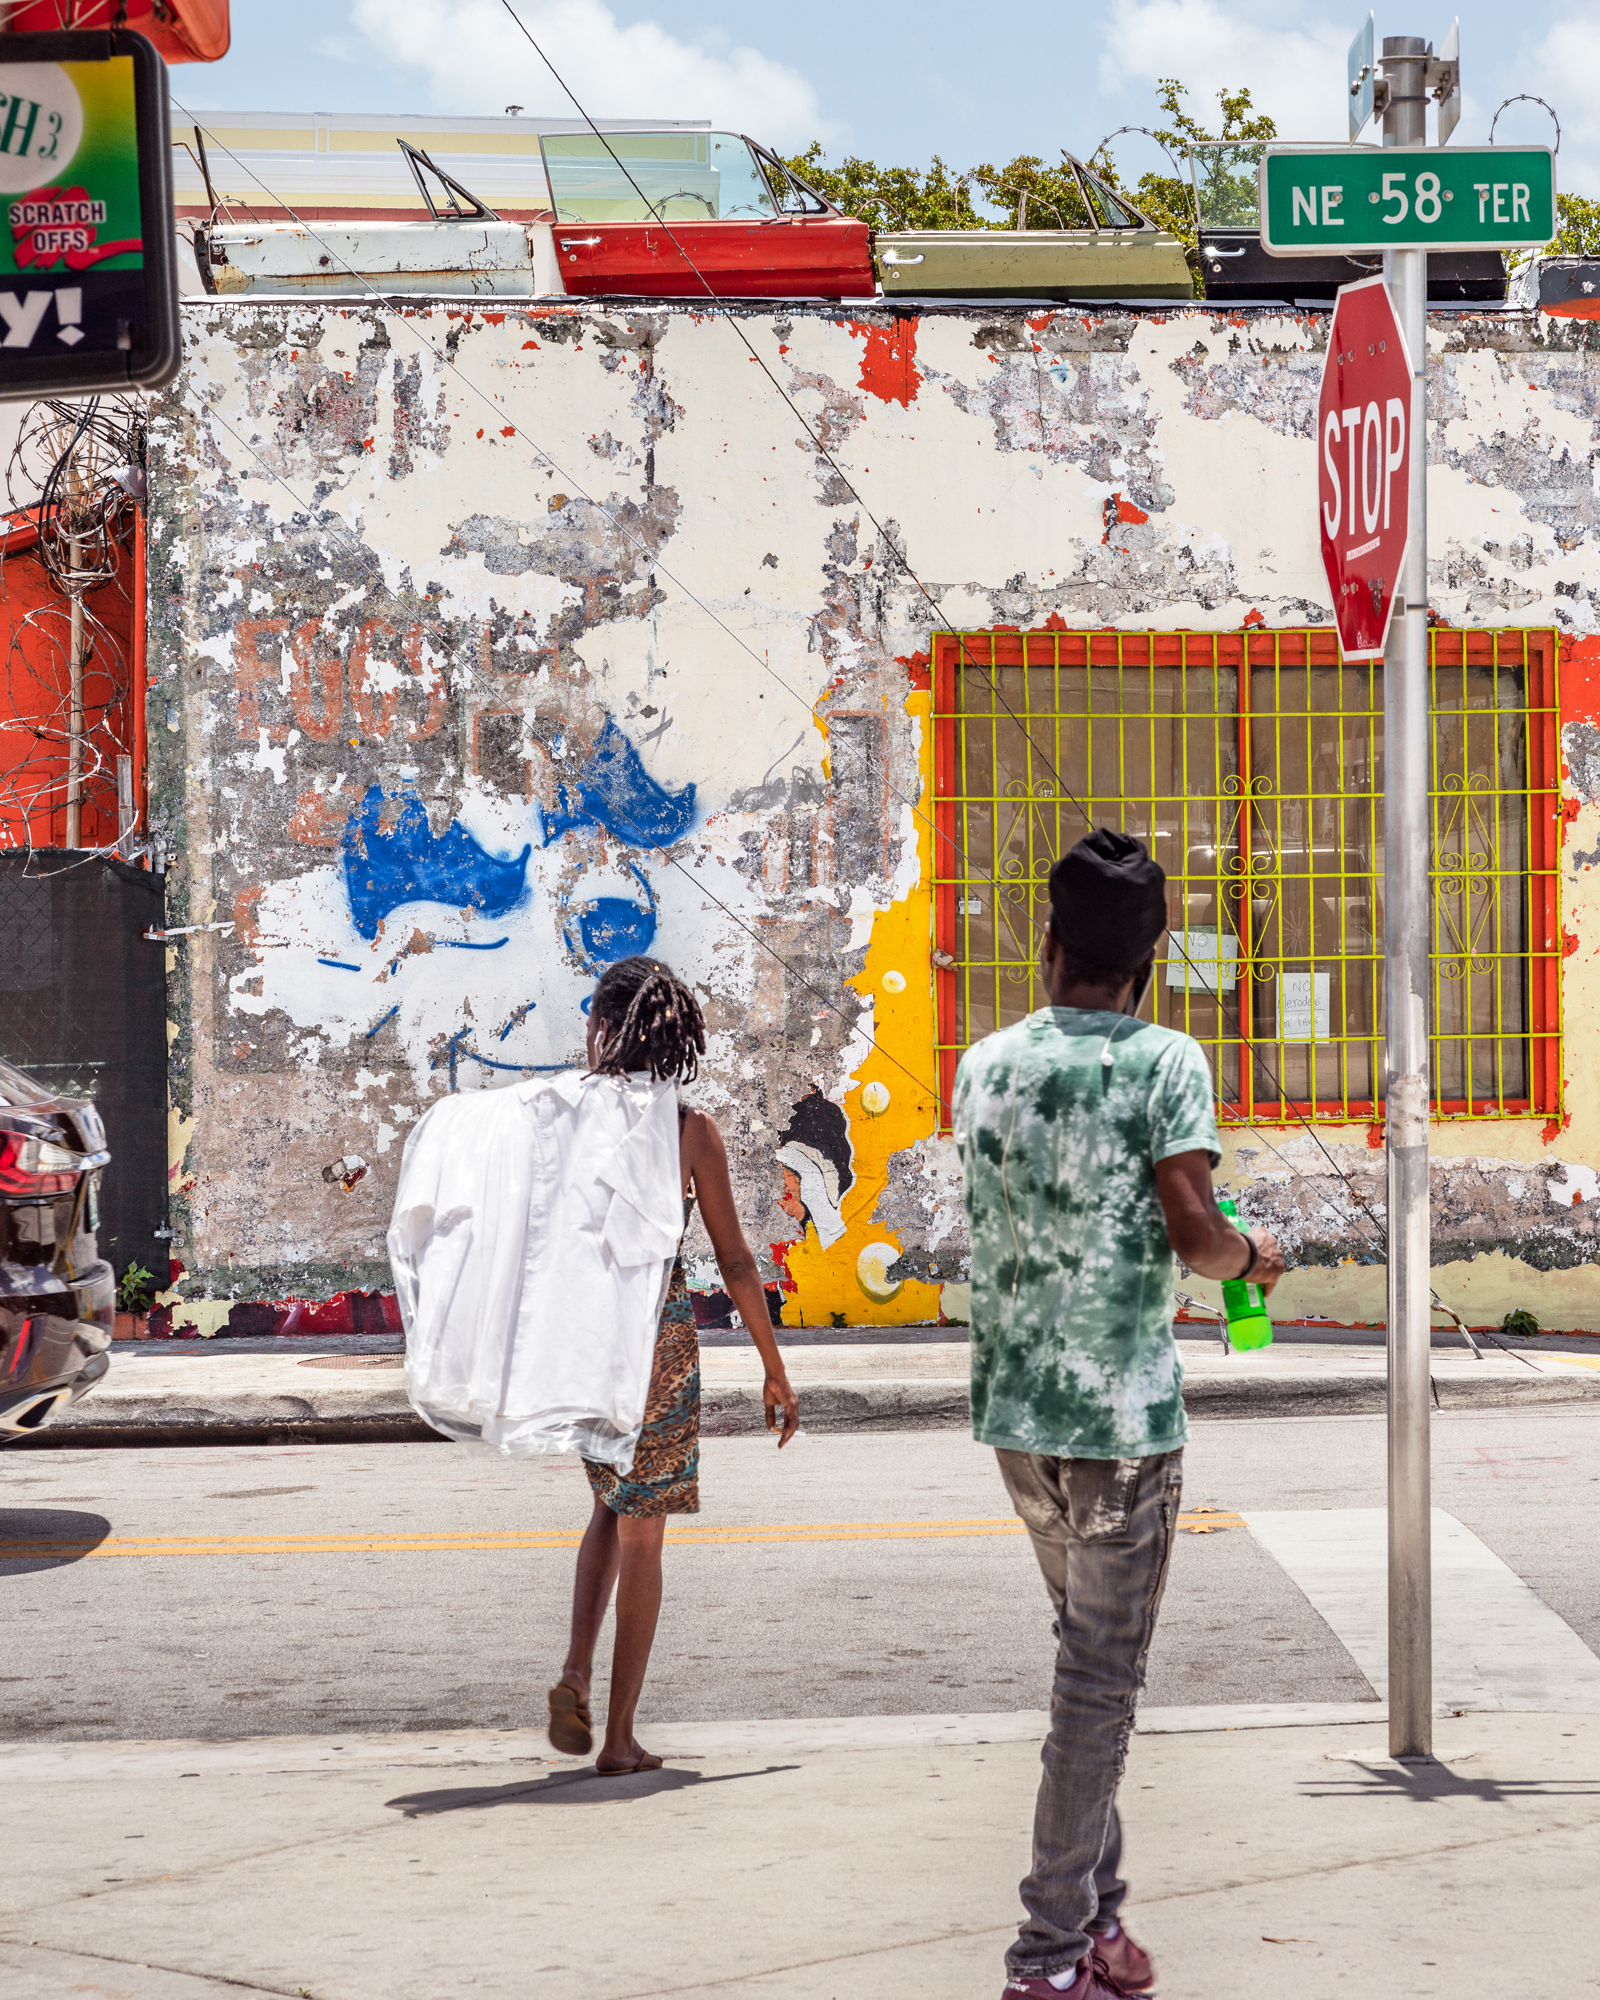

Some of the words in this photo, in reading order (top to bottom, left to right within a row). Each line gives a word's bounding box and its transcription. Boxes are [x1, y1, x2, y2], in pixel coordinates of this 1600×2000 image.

[1292, 186, 1344, 226] NE
[1382, 172, 1442, 224] 58
[1473, 183, 1531, 223] TER
[9, 201, 106, 226] SCRATCH
[33, 230, 88, 253] OFFS
[1324, 398, 1405, 540] STOP
[1187, 933, 1209, 948] NO
[1292, 980, 1312, 992] NO
